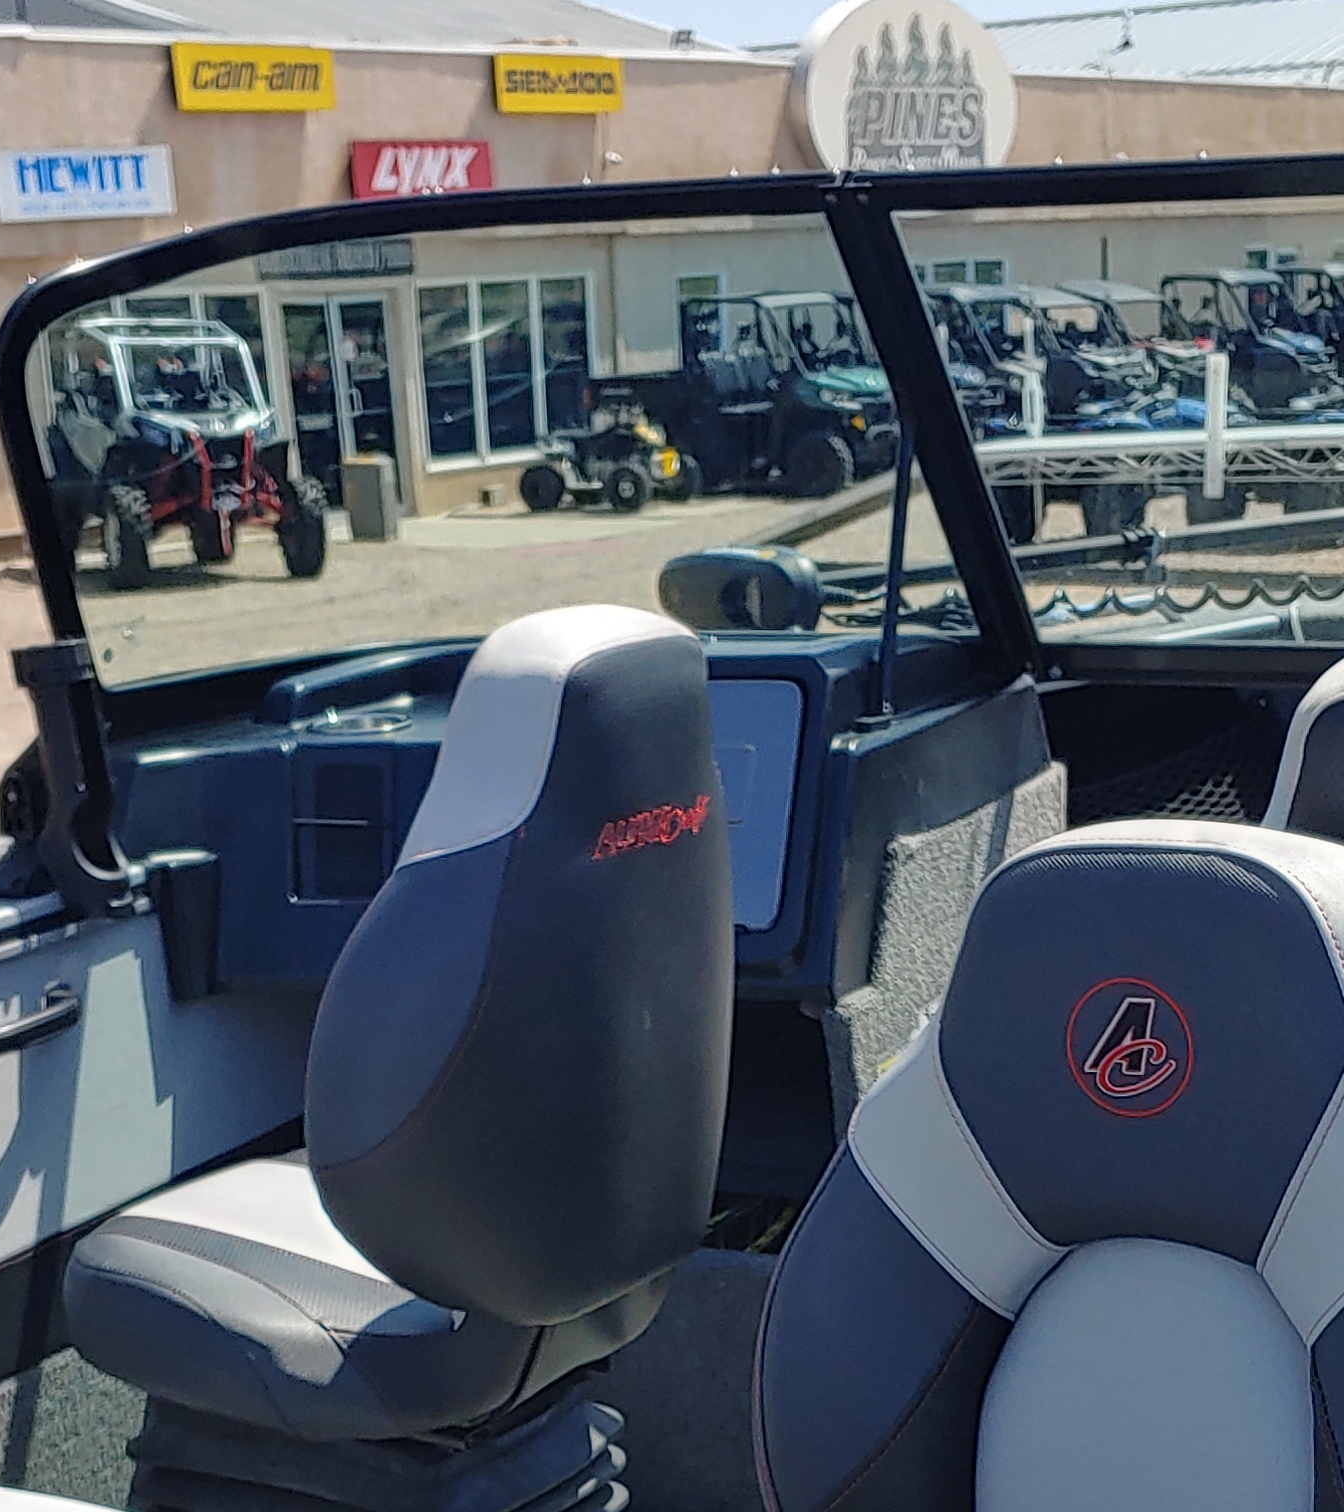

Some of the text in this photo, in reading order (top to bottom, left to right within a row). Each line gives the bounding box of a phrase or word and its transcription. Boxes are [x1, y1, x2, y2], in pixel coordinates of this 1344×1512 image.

[192, 60, 320, 91] can-am
[856, 89, 984, 145] PINES
[17, 154, 149, 194] HEWITT
[370, 147, 478, 193] LYNX
